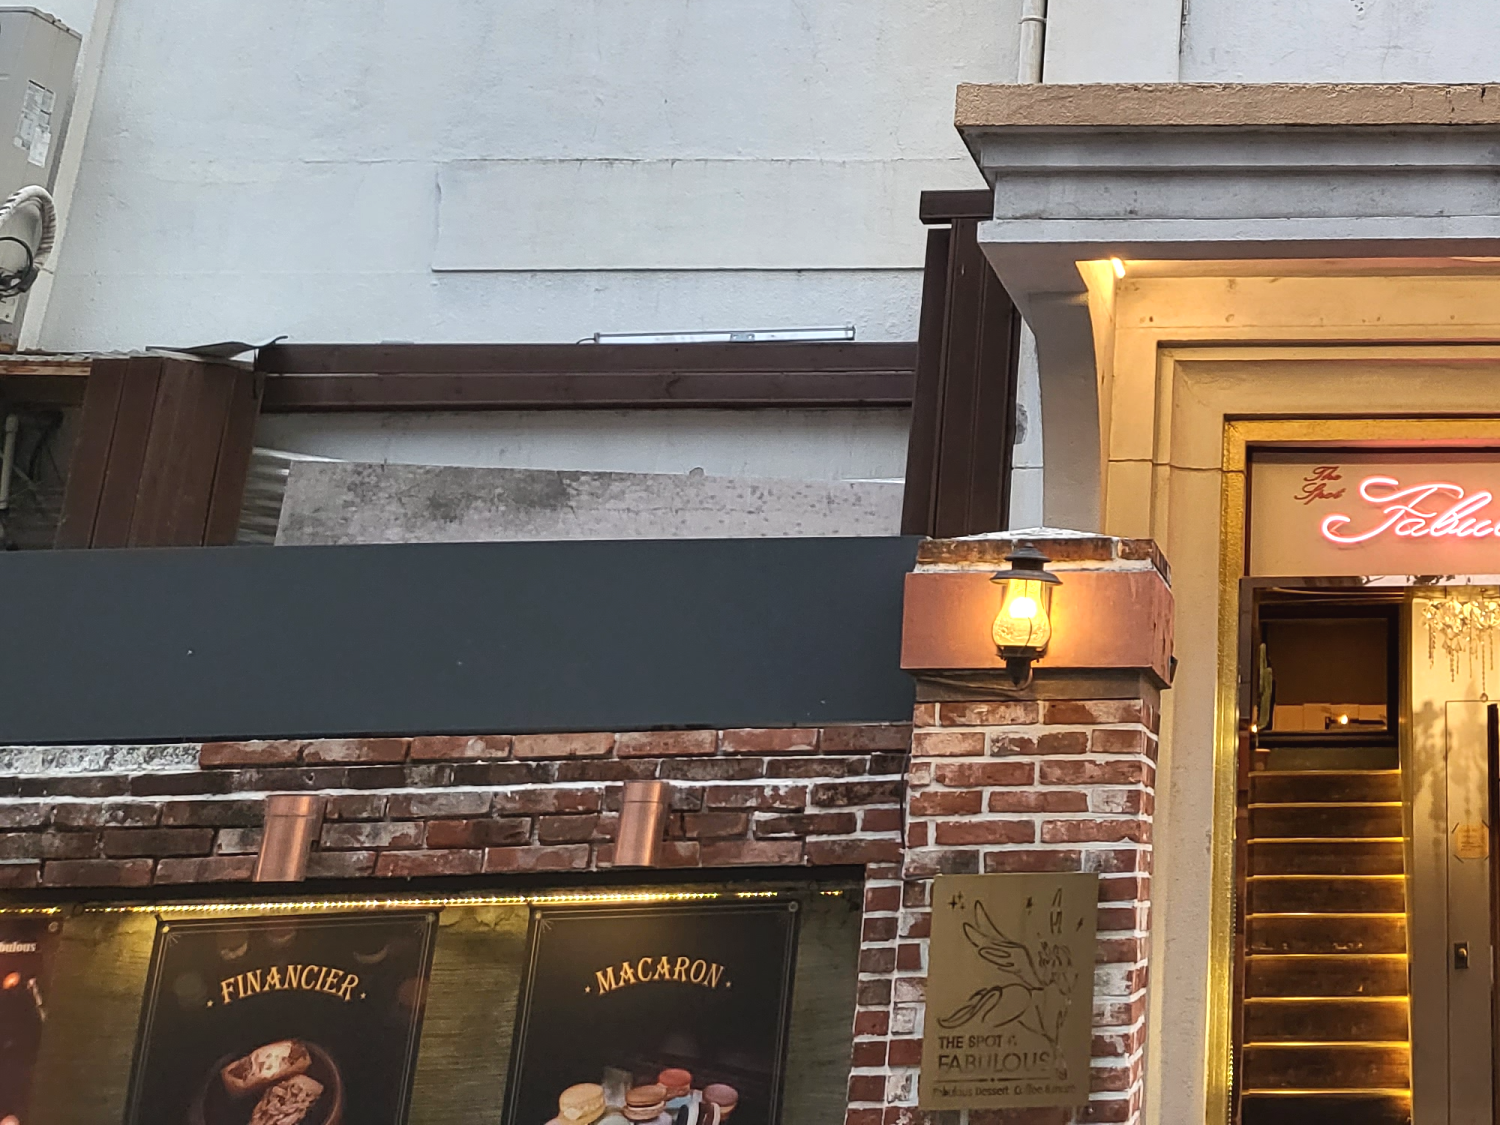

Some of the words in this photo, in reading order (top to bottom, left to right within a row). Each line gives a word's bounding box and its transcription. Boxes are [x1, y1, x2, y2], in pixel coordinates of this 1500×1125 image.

[1303, 466, 1342, 481] The
[1293, 483, 1347, 505] Spot
[220, 964, 359, 1005] FINANCIER
[595, 956, 725, 995] MACARON
[938, 1036, 964, 1050] THE
[968, 1034, 1003, 1048] SPOT
[938, 1052, 1050, 1073] FABULOUS
[975, 1085, 1009, 1096] Dessert
